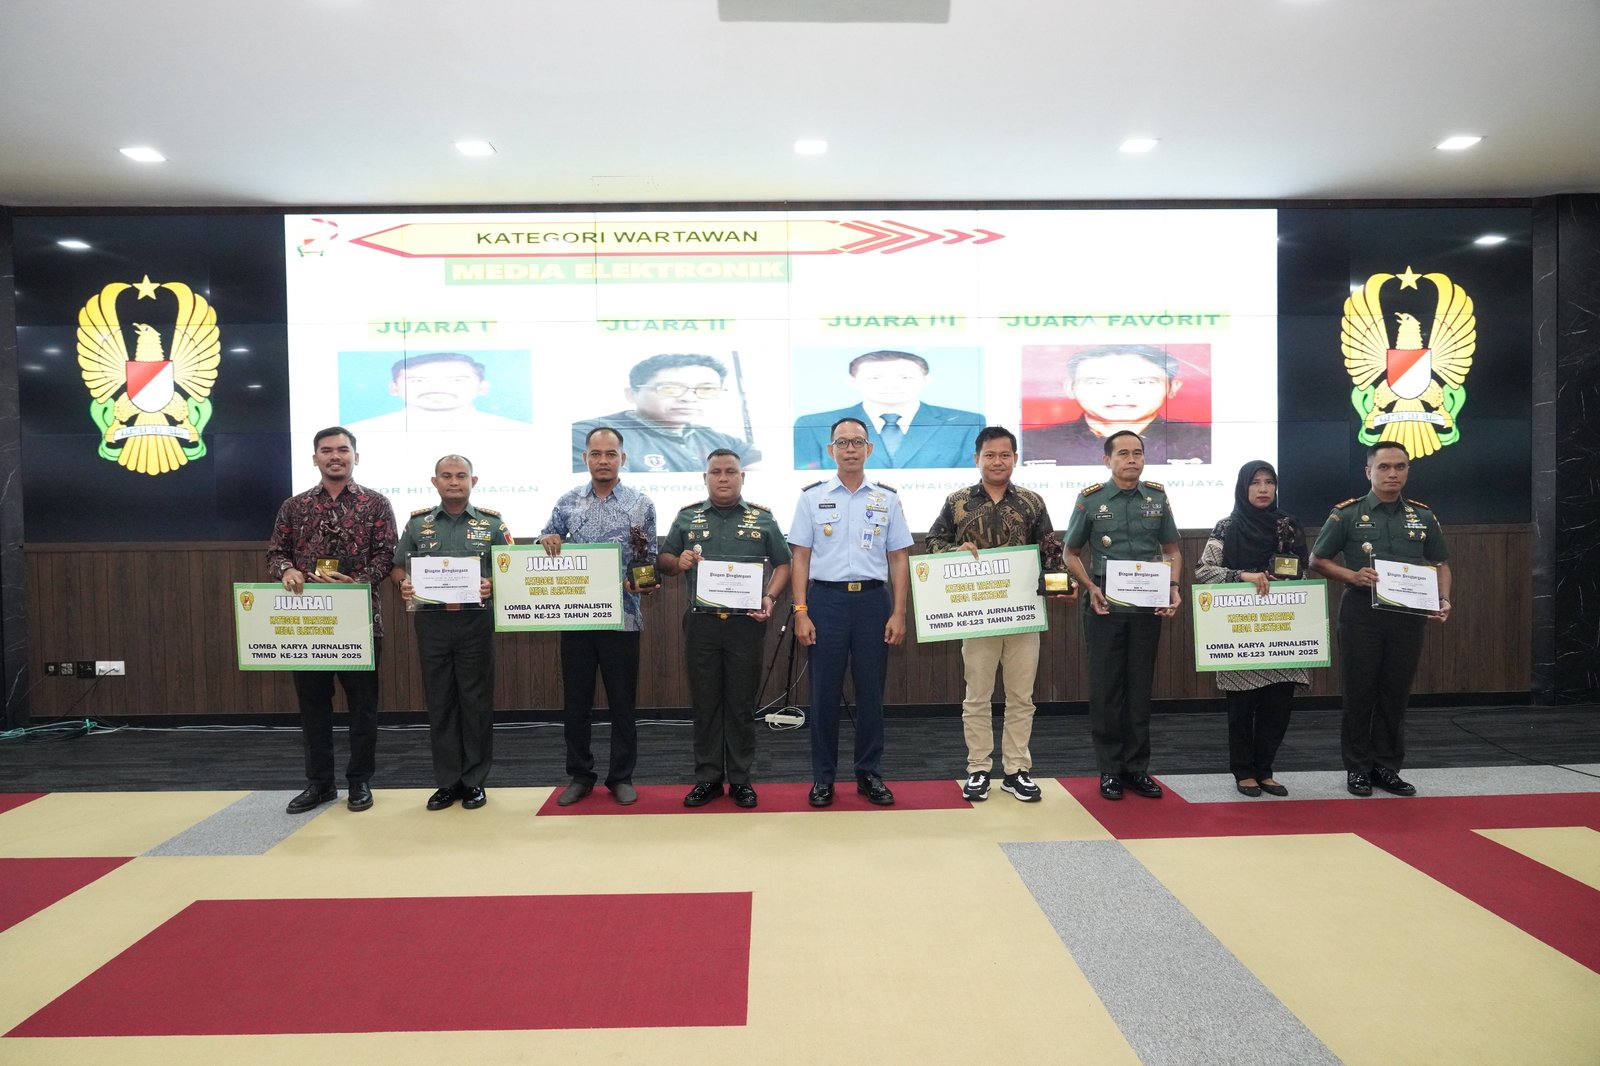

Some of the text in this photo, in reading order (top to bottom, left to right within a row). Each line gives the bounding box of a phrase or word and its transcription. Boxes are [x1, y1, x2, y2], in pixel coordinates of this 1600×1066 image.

[476, 230, 758, 245] KATEGORI WARTAWAN
[452, 261, 786, 280] MEDIA ELEKTRONIK
[606, 319, 726, 331] JUARA II
[827, 314, 956, 328] JUARA III
[1006, 313, 1221, 328] JUARA FAVORIT
[376, 321, 490, 334] JUARA I
[472, 485, 539, 494] SIAGIAN
[1166, 480, 1224, 488] WIJAYA
[526, 556, 588, 572] JUARA II
[943, 559, 1010, 579] JUARA III
[525, 576, 589, 585] KATEGORI WARTAWAN
[945, 579, 1011, 593] KATEGORI WARTAWAN
[529, 586, 586, 596] MEDIA ELEKTRONIK
[950, 589, 1008, 603] MEDIA ELEKTRONIK
[274, 595, 333, 611] JUARA I
[564, 602, 613, 610] JURNALISTIK
[1213, 591, 1307, 608] JUARA FAVORIT
[925, 604, 1036, 621] LOMBA KARYA JURNALISTIK
[1227, 612, 1295, 623] KATEGORI WARTAWAN
[269, 616, 338, 625] KATEGORI WARTAWAN
[929, 622, 954, 630] TMMD
[957, 619, 984, 627] KE-123
[987, 616, 1013, 624] TAHUN
[275, 626, 334, 635] MEDIA ELEKTRONIK
[1232, 622, 1291, 633] MEDIA ELEKTRONIK
[1268, 640, 1319, 648] JURNALISTIK
